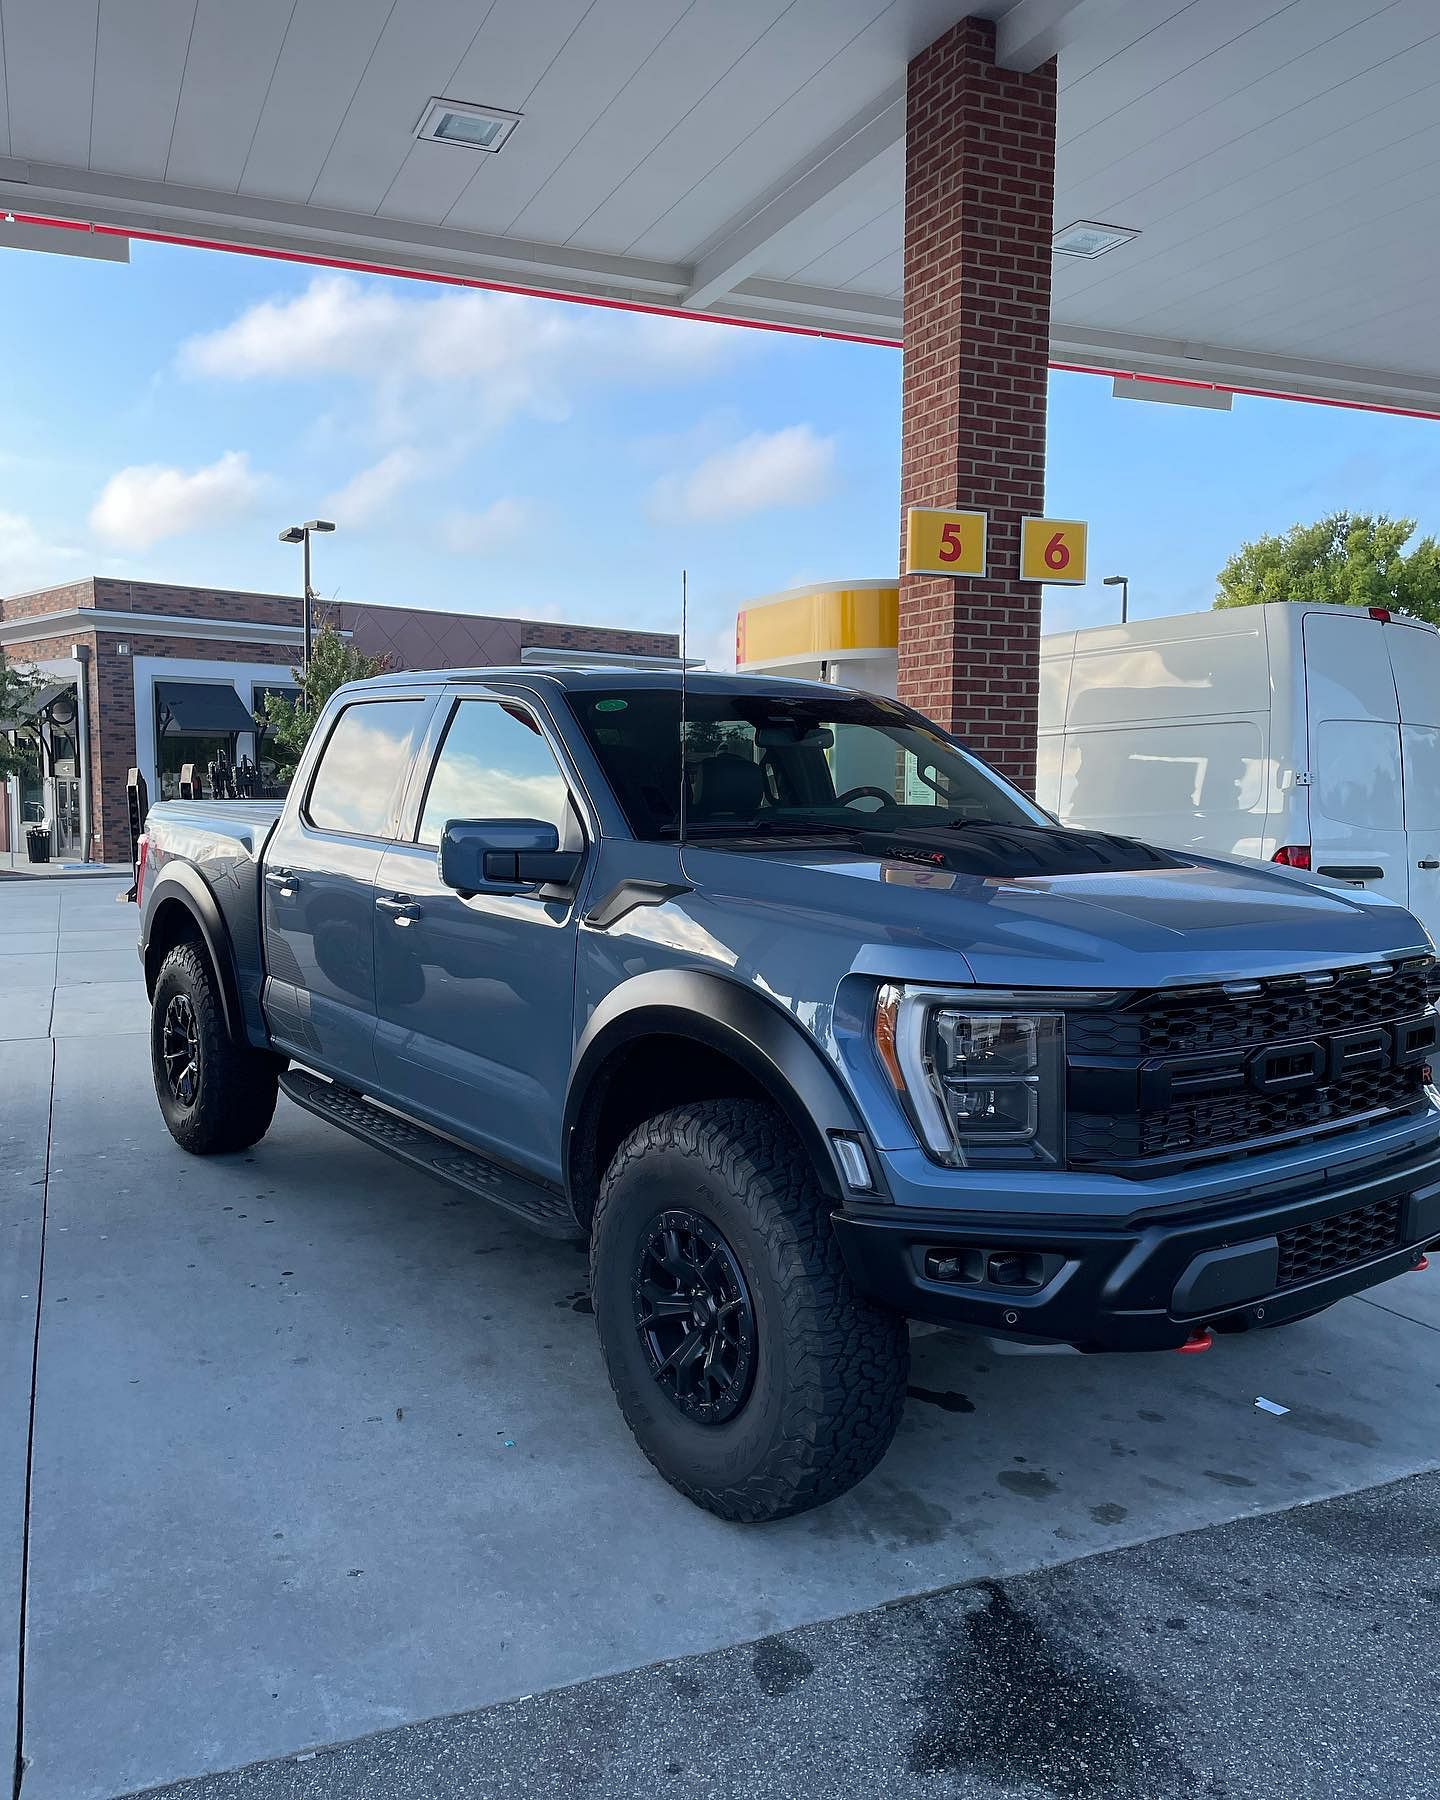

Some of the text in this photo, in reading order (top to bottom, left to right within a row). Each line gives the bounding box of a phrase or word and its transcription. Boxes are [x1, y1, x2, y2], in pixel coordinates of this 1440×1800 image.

[938, 523, 962, 563] 5
[1044, 532, 1070, 571] 6
[1138, 1014, 1440, 1110] FORD
[1422, 1066, 1433, 1083] R
